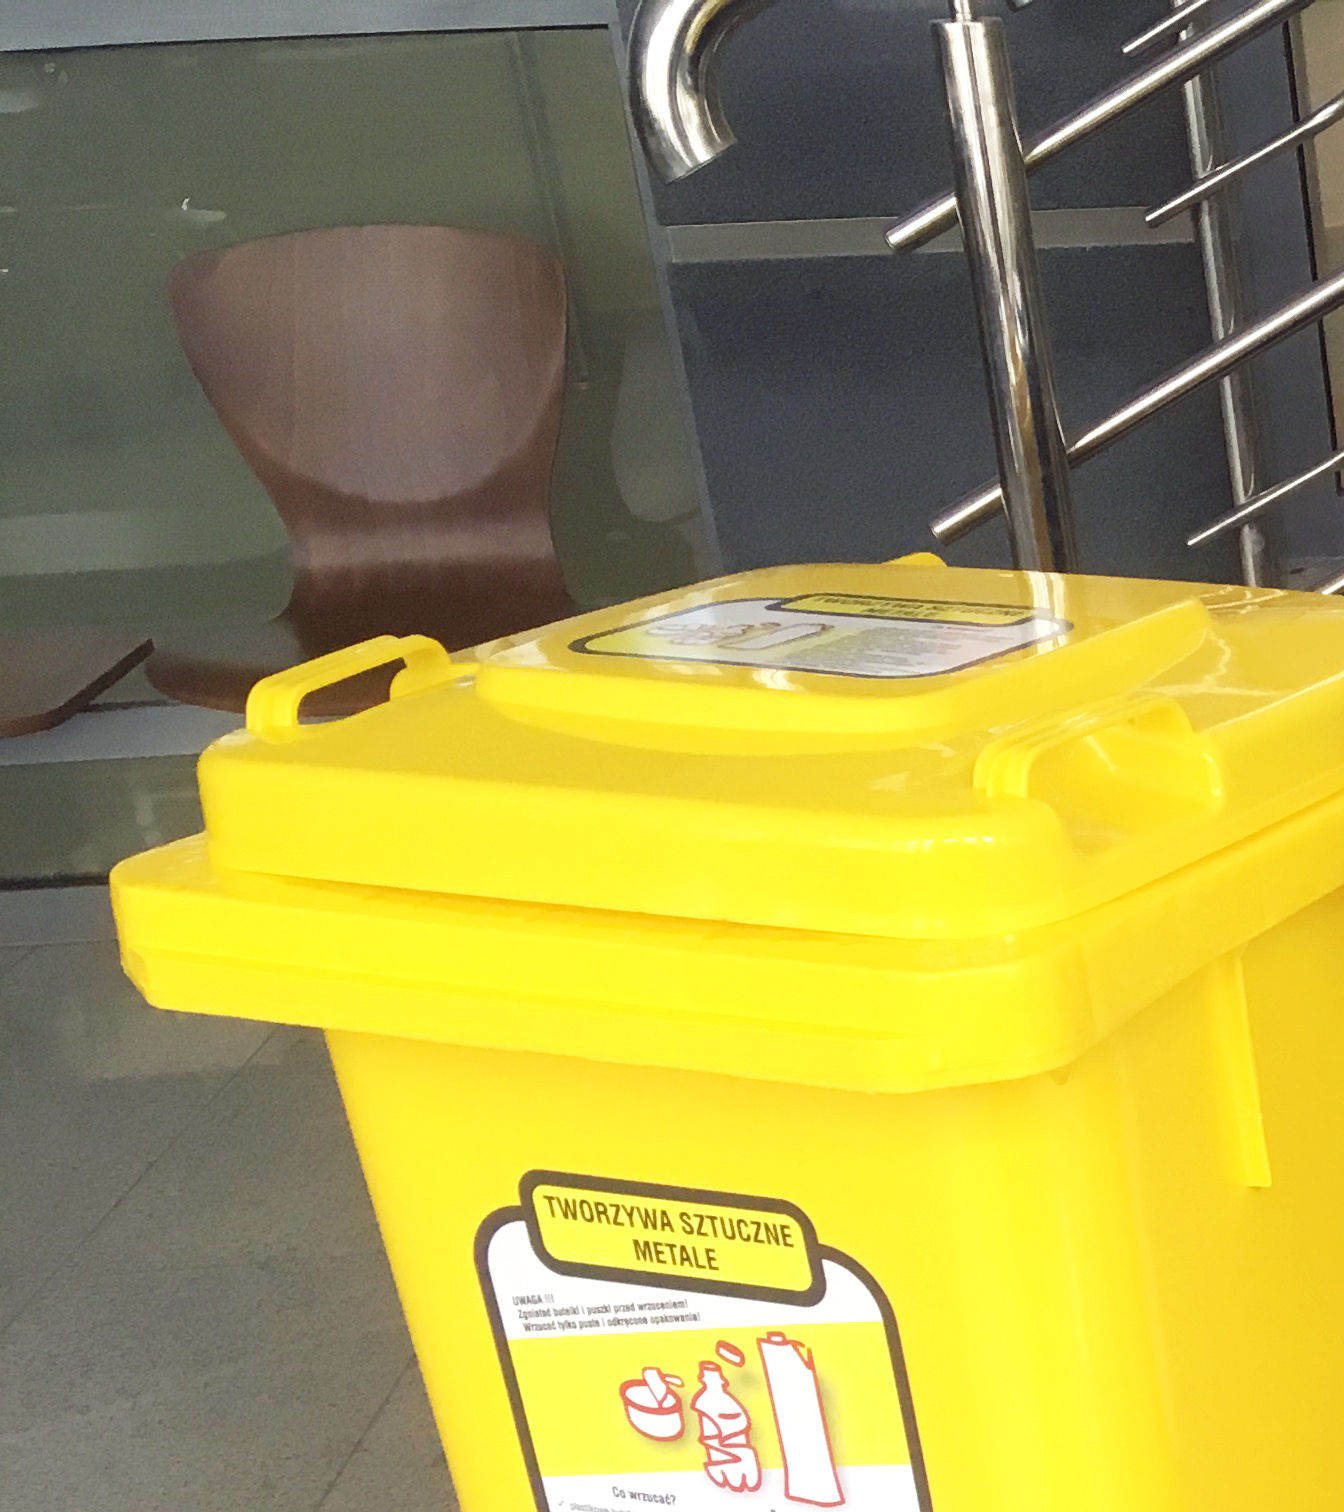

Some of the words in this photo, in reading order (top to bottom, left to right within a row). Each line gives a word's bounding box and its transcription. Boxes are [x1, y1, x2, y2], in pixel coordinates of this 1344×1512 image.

[544, 1195, 675, 1233] TWORZYWA
[679, 1212, 795, 1248] SZTUCZNE
[633, 1238, 719, 1271] METALE
[612, 1486, 626, 1498] Co
[628, 1491, 676, 1505] wrzucać?
